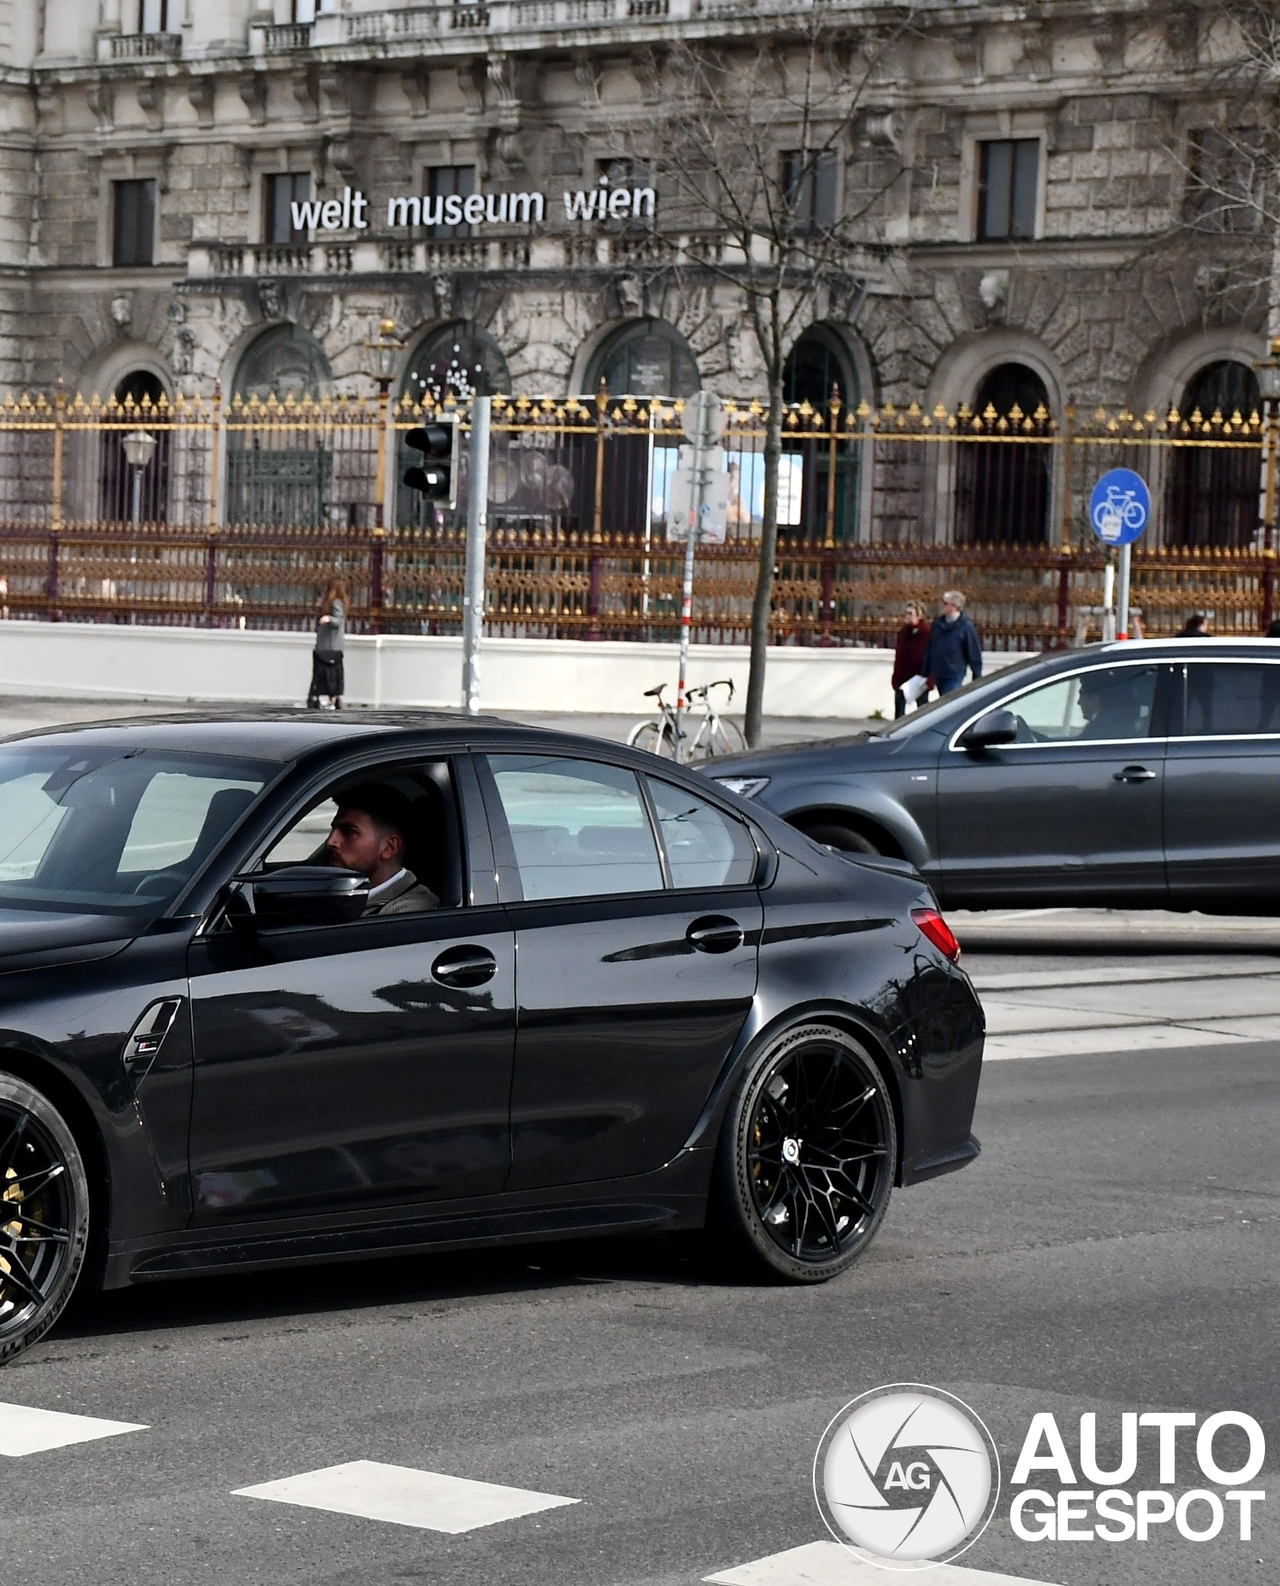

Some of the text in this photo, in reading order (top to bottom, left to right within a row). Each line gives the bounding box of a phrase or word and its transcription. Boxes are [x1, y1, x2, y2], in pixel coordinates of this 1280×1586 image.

[291, 175, 656, 230] welt museum wien
